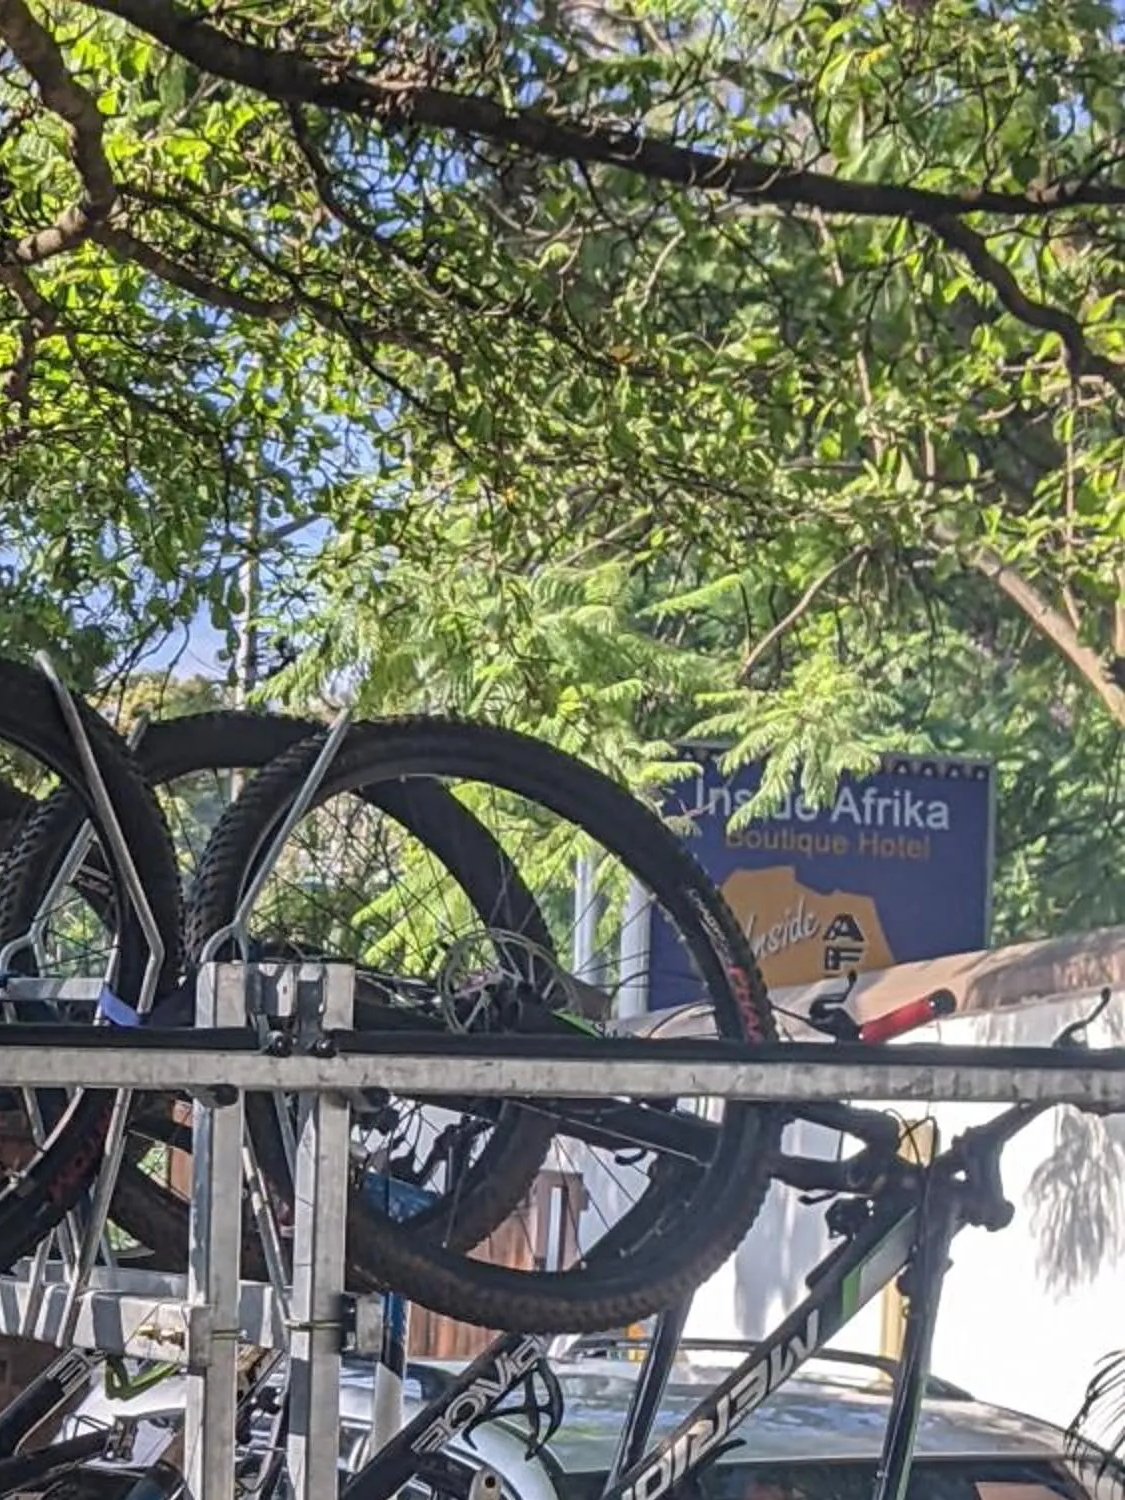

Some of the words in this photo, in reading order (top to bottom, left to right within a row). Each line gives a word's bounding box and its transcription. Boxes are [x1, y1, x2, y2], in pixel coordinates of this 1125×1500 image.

[831, 785, 951, 831] Afrika
[725, 827, 849, 860] Boutique
[857, 831, 931, 862] Hotel
[410, 1332, 548, 1454] PACE
